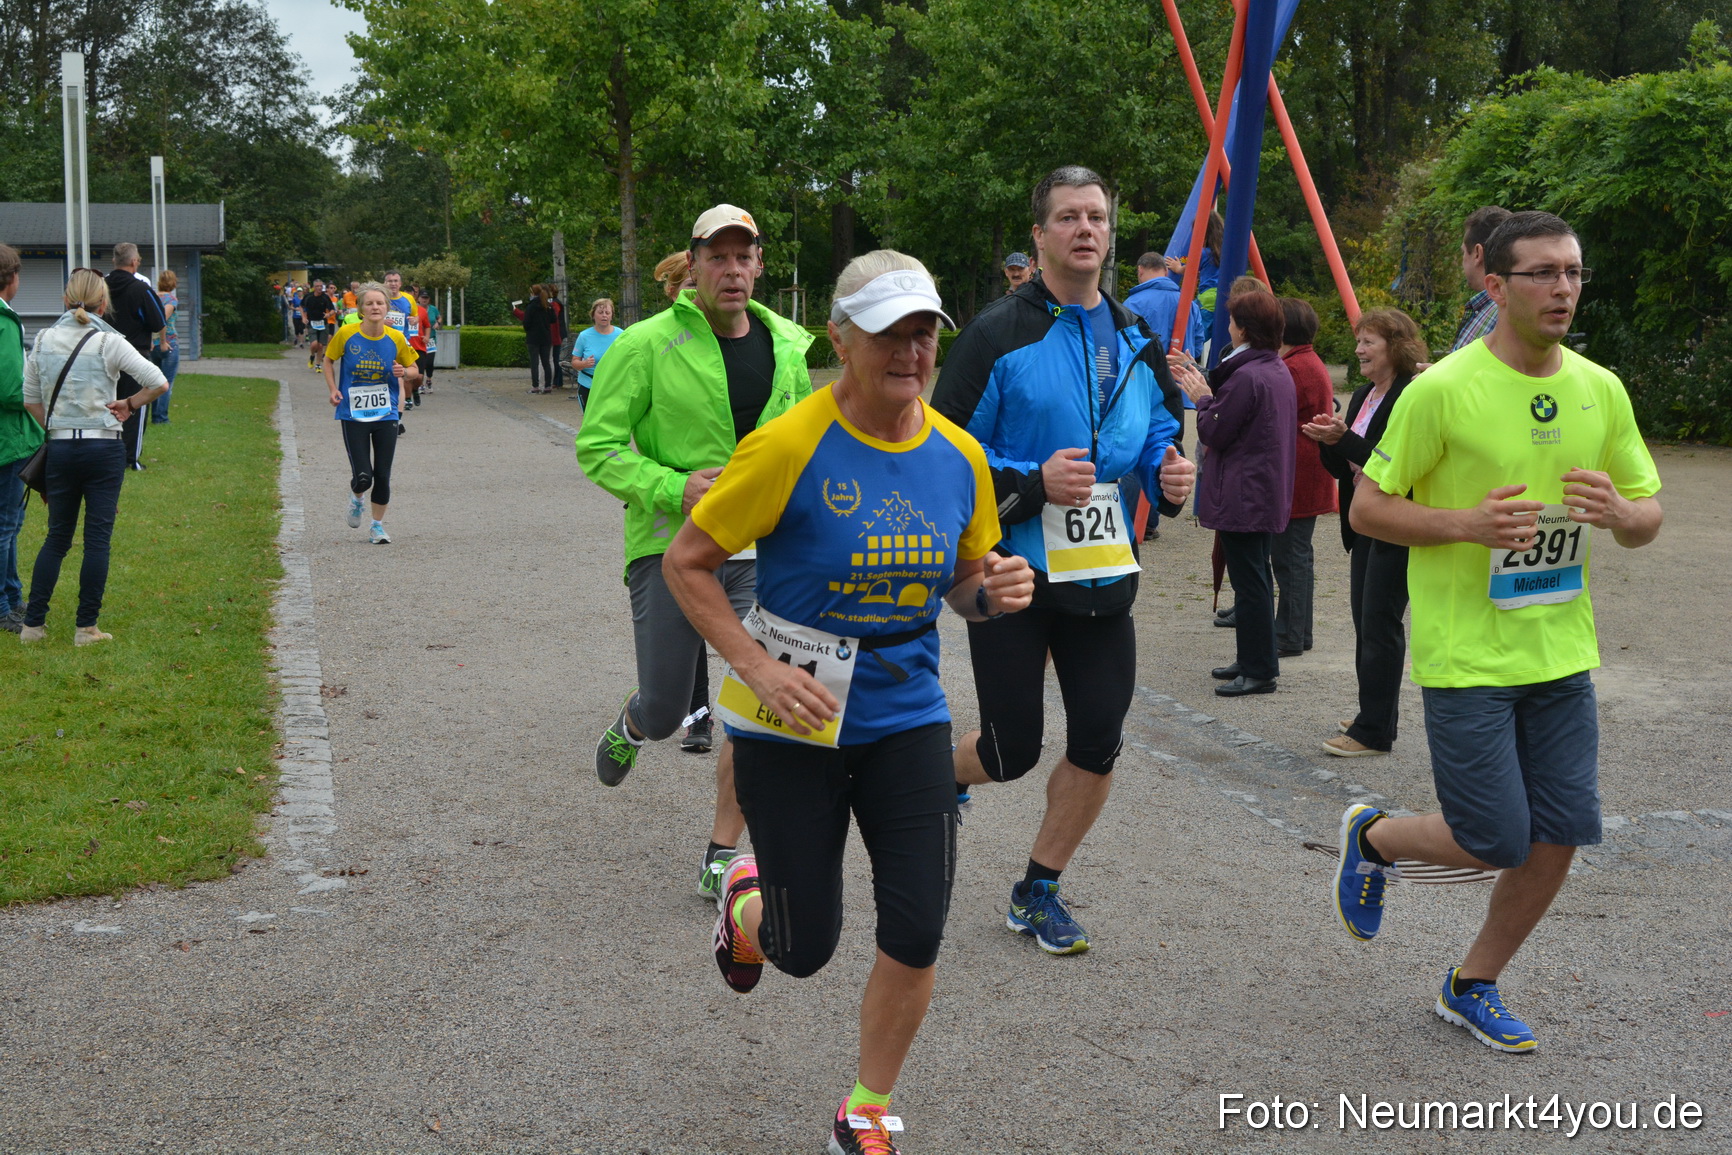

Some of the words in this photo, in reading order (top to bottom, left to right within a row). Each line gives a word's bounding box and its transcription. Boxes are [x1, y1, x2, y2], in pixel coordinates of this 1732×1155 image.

[354, 393, 387, 408] 2705
[1530, 428, 1561, 440] Partl
[1531, 438, 1561, 446] Neumarkt
[837, 482, 847, 490] 15
[831, 493, 855, 502] Jahre
[1090, 492, 1113, 502] umarkt
[1065, 506, 1117, 543] 624
[850, 570, 919, 581] 21.September
[920, 570, 943, 579] 2014
[1514, 573, 1561, 593] Michael
[746, 610, 767, 635] PARTL
[769, 626, 831, 656] Neumarkt
[756, 702, 783, 728] Eva
